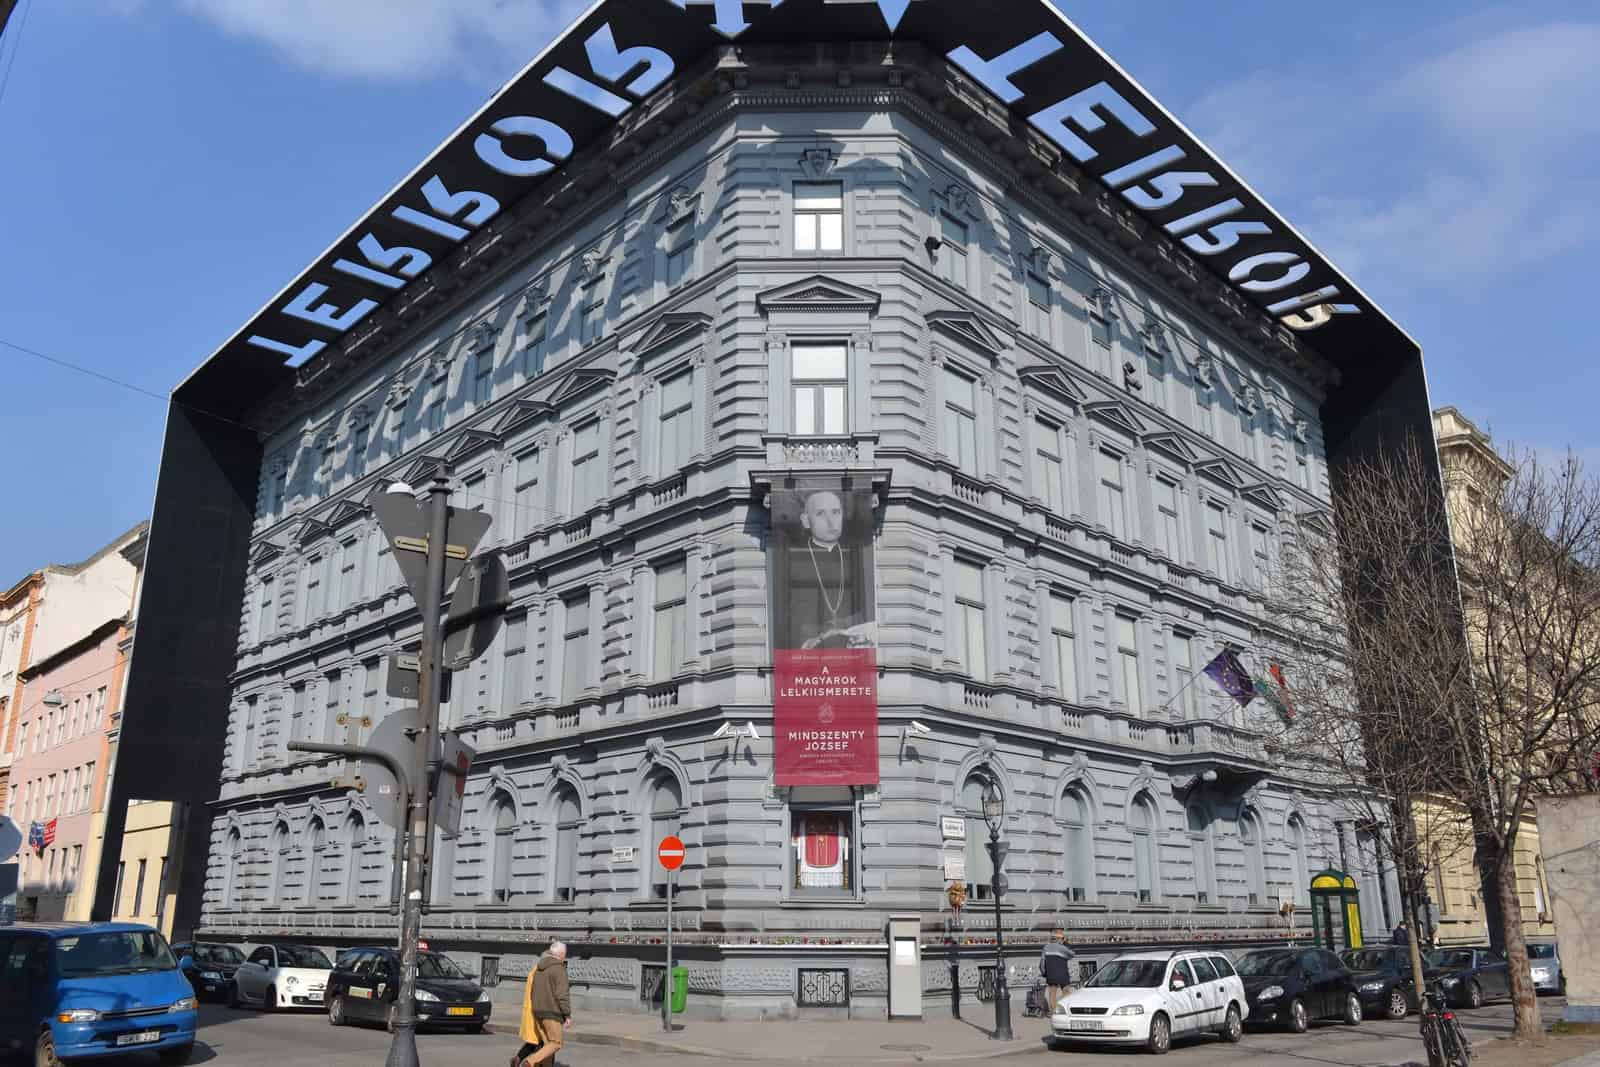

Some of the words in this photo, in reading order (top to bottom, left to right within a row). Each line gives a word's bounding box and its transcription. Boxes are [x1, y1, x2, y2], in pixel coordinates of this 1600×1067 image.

[822, 665, 829, 675] A
[794, 676, 857, 686] MAGYAROK
[780, 687, 872, 697] LELKIISMERETE
[788, 730, 865, 741] MINDSZENTY
